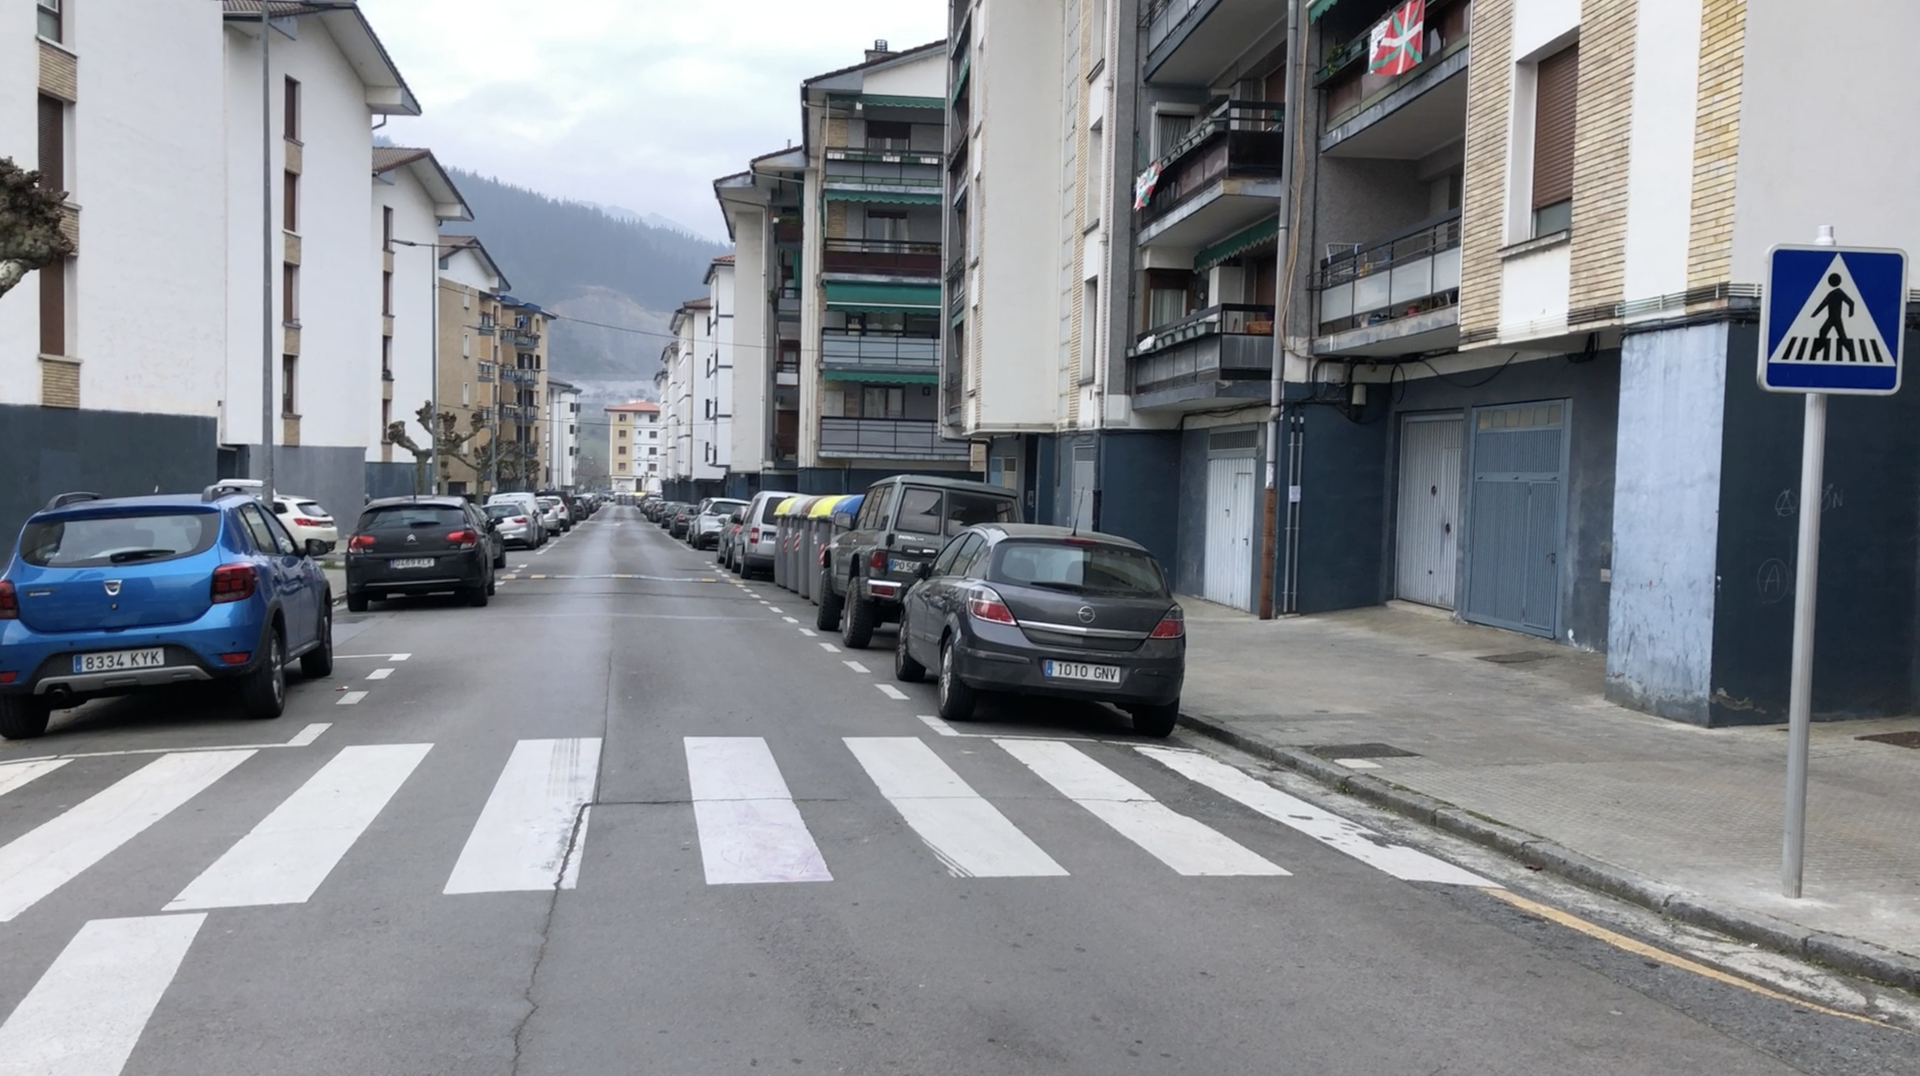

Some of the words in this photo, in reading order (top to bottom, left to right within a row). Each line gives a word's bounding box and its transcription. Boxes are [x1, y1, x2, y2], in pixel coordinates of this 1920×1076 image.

[85, 654, 125, 670] 8334
[130, 651, 160, 667] KYK
[1058, 663, 1088, 678] 1010
[1094, 667, 1117, 680] GNV
